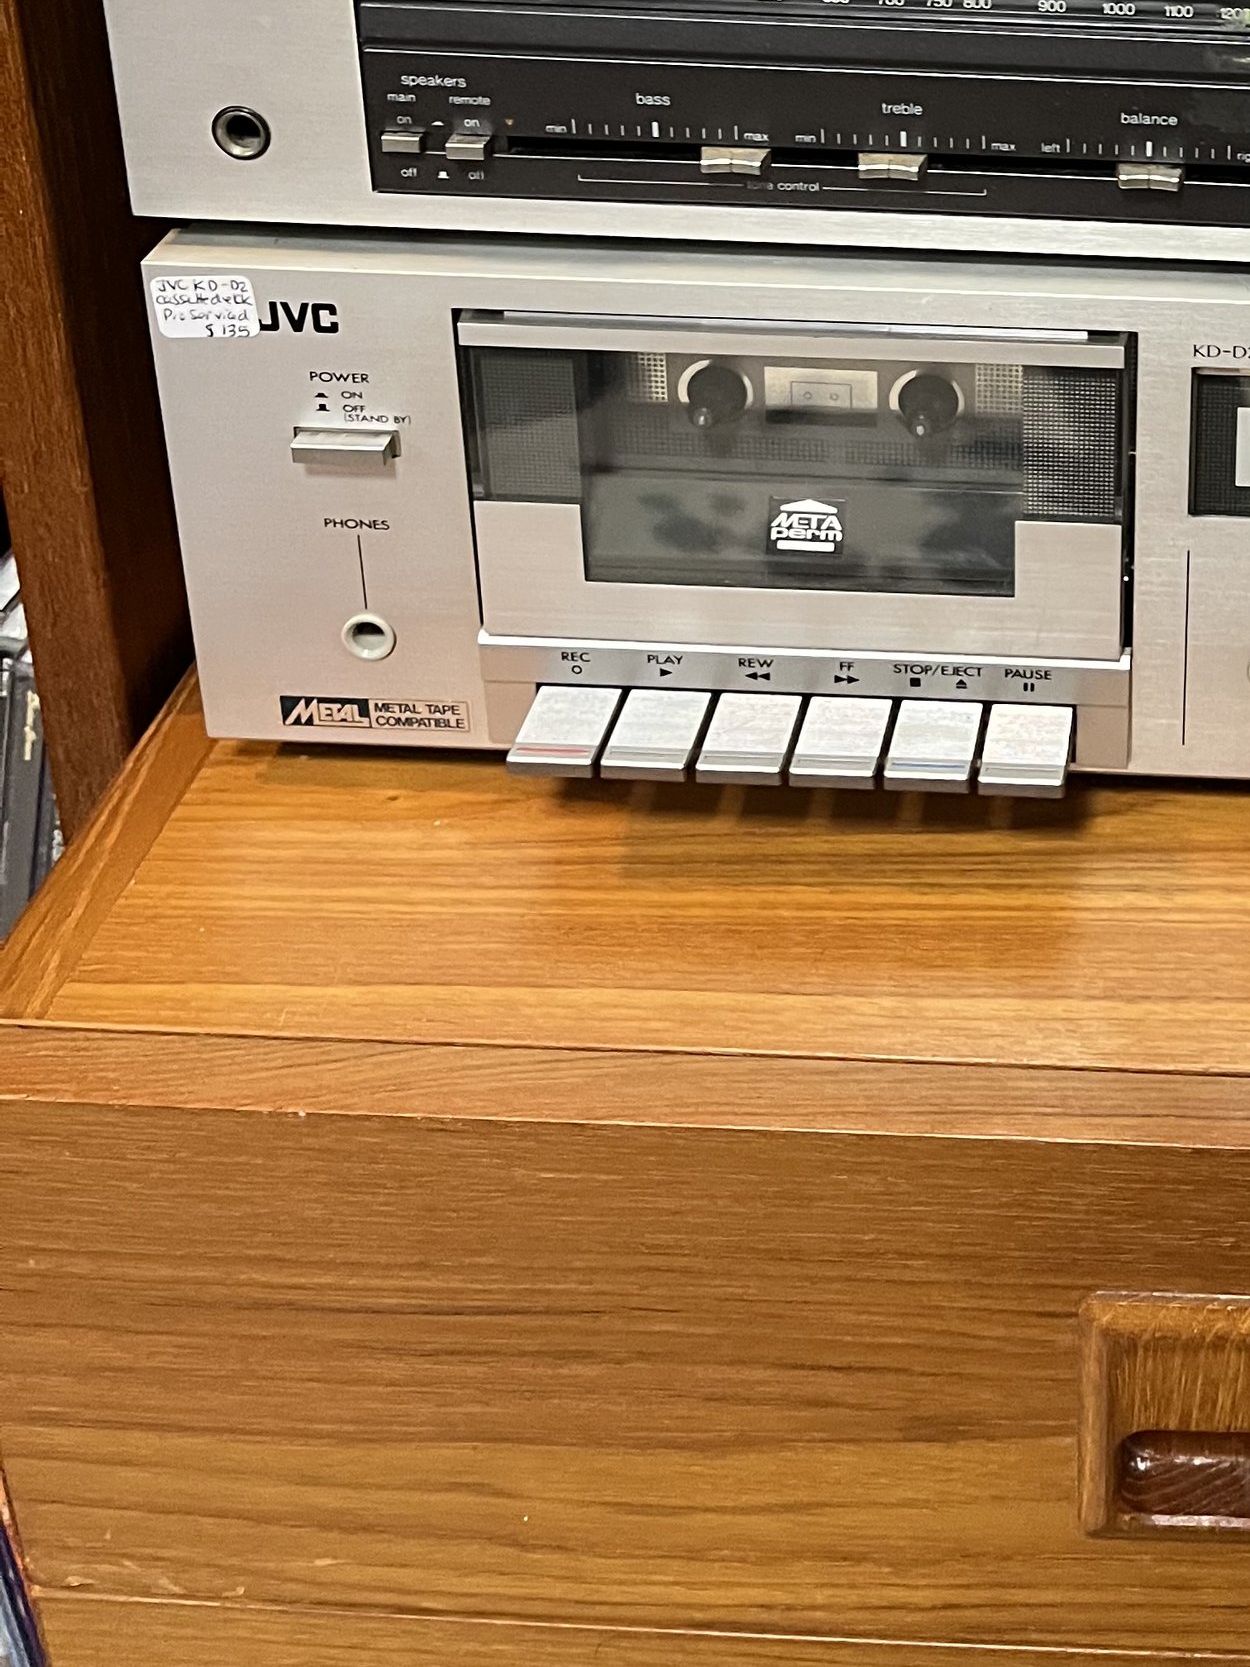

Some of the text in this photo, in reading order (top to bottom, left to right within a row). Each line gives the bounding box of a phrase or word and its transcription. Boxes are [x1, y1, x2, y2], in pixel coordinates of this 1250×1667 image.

[1038, 0, 1067, 13] 900
[1102, 2, 1136, 16] 1000
[1164, 5, 1194, 18] 1100
[400, 74, 467, 88] speakers
[387, 92, 491, 106] main remote
[635, 93, 671, 106] bass
[881, 102, 923, 116] treble
[396, 115, 412, 125] on
[463, 118, 480, 129] on
[1120, 113, 1178, 126] balance
[545, 124, 770, 142] min max
[795, 134, 1017, 152] min max
[1040, 142, 1061, 153] left
[777, 181, 820, 192] control
[156, 279, 188, 292] JVC
[259, 300, 339, 334] JVC
[309, 371, 370, 384] POWER
[341, 391, 363, 399] ON
[342, 404, 366, 413] OFF
[323, 517, 390, 531] PHONES
[770, 512, 843, 530] META
[560, 651, 591, 663] REC
[646, 654, 683, 665] PLAY
[738, 657, 774, 669] REW
[839, 661, 855, 672] FF
[893, 662, 983, 677] STOP/EJECT
[1004, 667, 1053, 680] PAUSE
[374, 702, 462, 716] METAL TAPE
[375, 715, 465, 729] COMPATIBLE
